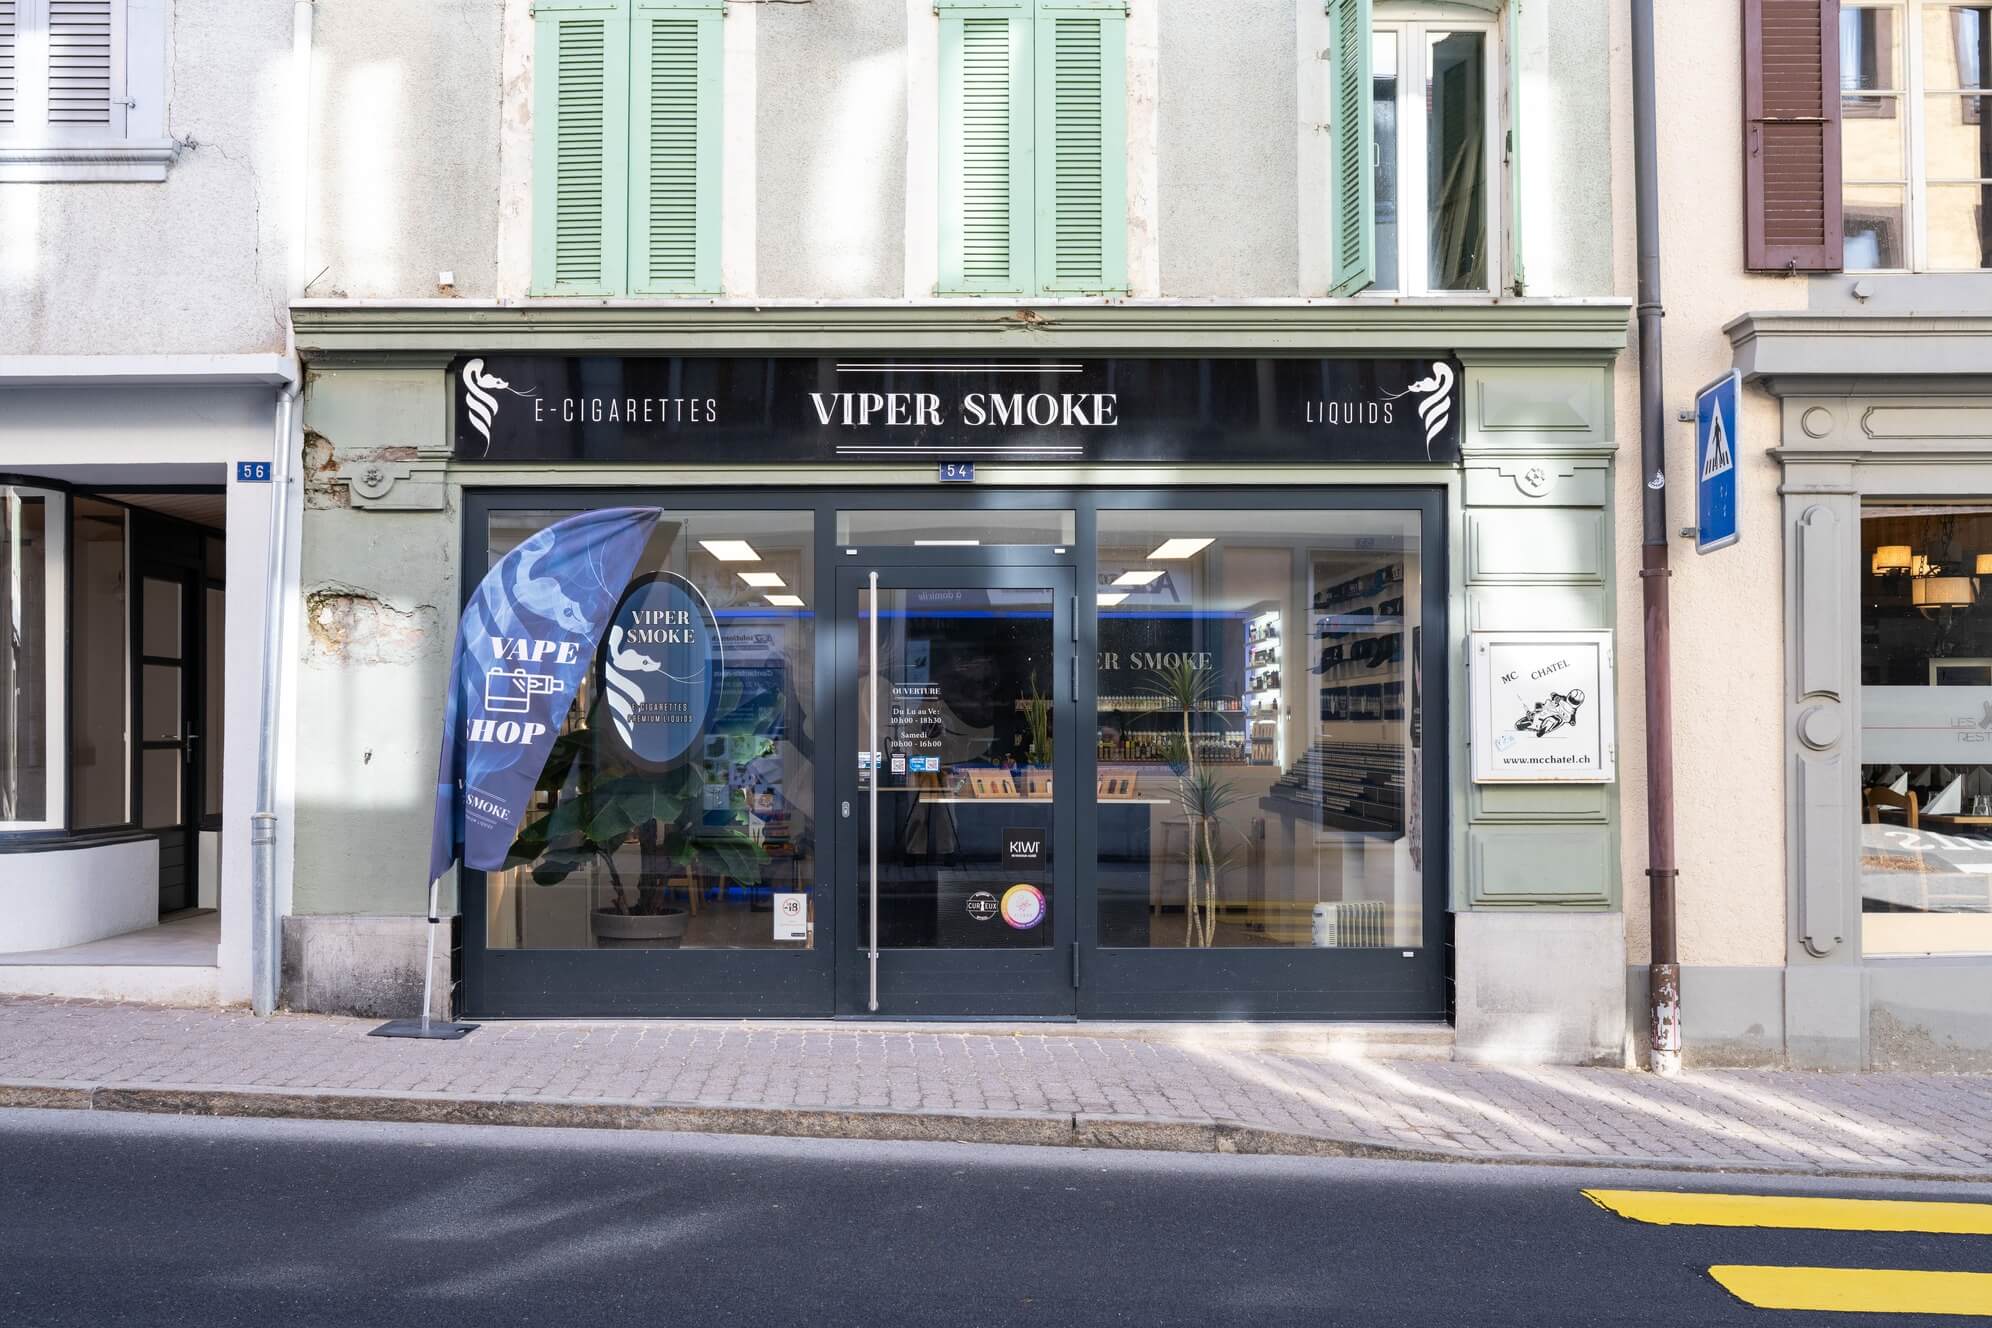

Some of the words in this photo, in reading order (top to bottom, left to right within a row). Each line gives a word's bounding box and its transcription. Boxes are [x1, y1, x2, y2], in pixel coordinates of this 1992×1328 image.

[535, 398, 717, 423] E-CIGARETTES
[808, 392, 944, 426] VIPER
[963, 392, 1118, 426] SMOKE
[1306, 400, 1393, 425] LIQUIDS
[243, 464, 264, 478] 56
[947, 464, 966, 477] 54
[631, 610, 690, 625] VIPER
[626, 629, 695, 643] SMOKE
[489, 637, 580, 665] VAPE
[1130, 652, 1213, 670] SMOKE
[1501, 671, 1519, 685] MC
[1530, 659, 1571, 680] CHATEL
[892, 687, 942, 695] OUVERTURE
[627, 714, 660, 723] PREMIUM
[663, 715, 693, 723] LIQUIDS
[467, 719, 546, 745] HOP
[1504, 755, 1590, 764] www.mcchatel.ch
[466, 794, 511, 821] SMOKE
